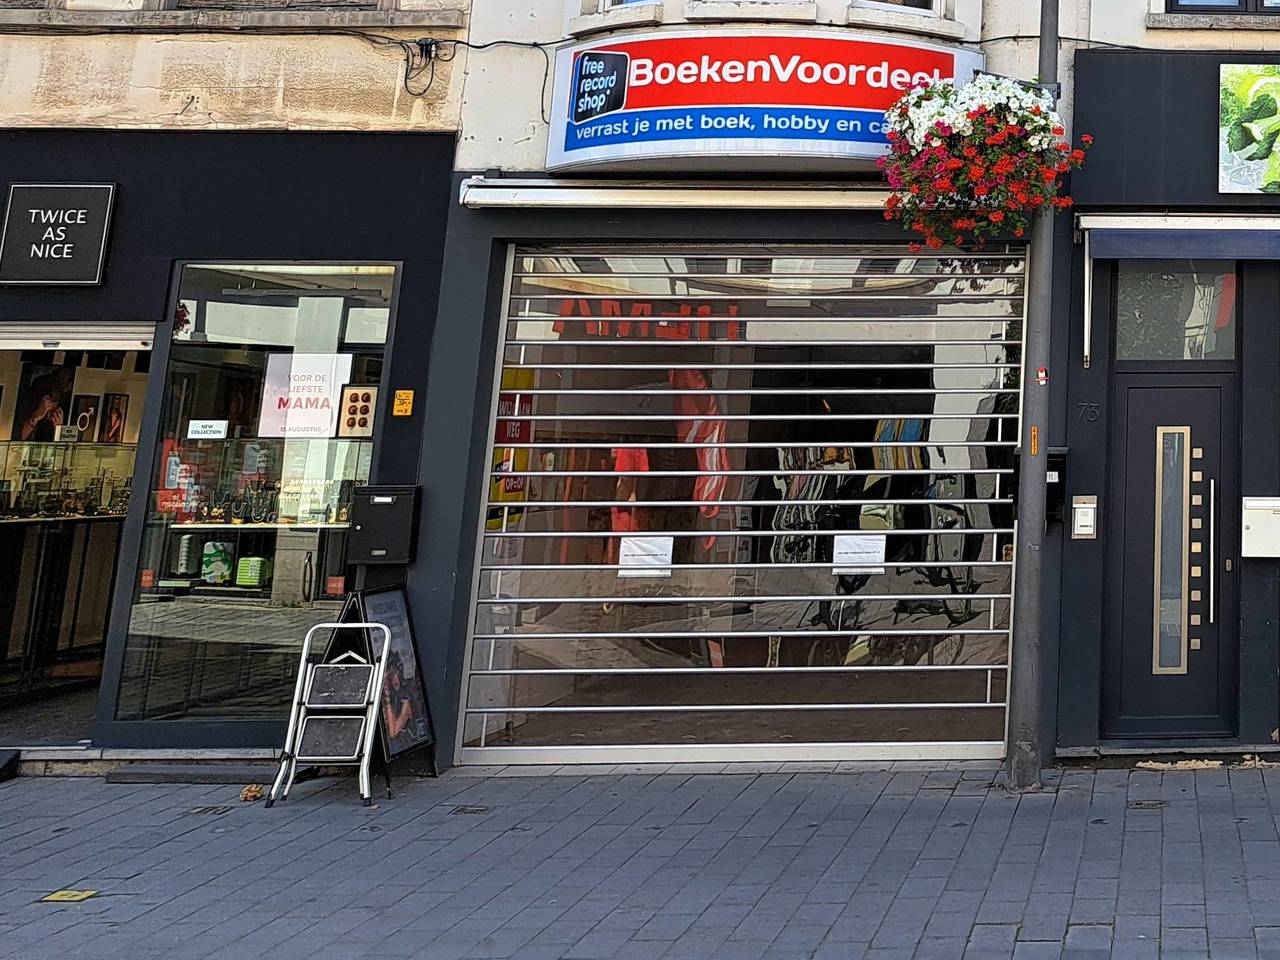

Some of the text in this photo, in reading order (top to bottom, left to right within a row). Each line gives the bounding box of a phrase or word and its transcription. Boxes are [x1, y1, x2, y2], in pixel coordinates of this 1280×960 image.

[582, 56, 604, 76] free
[579, 70, 617, 93] record
[576, 113, 890, 140] verrast je met boek, hobby en ca
[28, 209, 88, 224] TWICE
[42, 226, 67, 241] AS
[30, 243, 74, 258] NICE
[314, 374, 327, 382] DE
[277, 397, 331, 410] MAMA
[1078, 402, 1100, 421] 73
